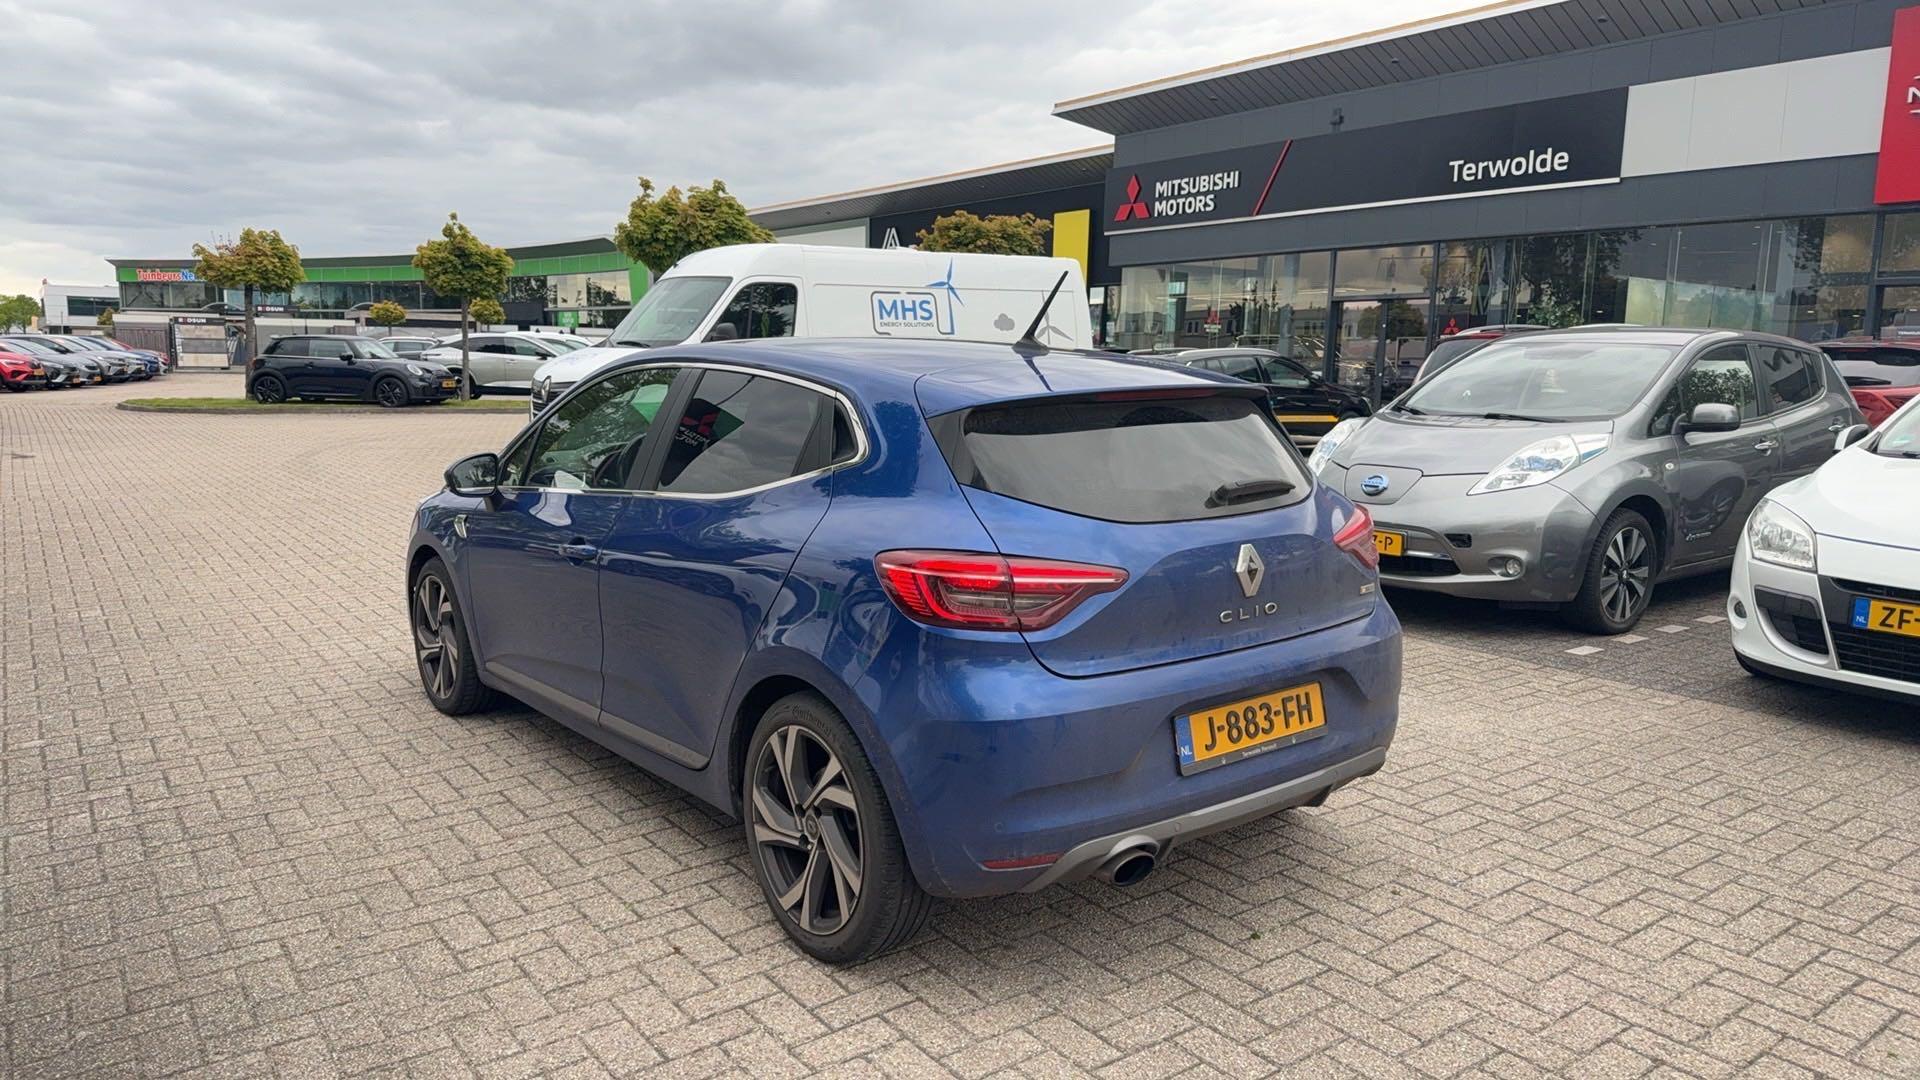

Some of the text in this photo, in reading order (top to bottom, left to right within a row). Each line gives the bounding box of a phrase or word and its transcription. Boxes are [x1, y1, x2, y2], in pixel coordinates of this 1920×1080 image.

[1449, 147, 1569, 182] Terwolde
[1155, 170, 1239, 198] MITSUBISHI
[1154, 194, 1215, 217] MOTORS
[136, 268, 196, 282] TuinbeursNe
[878, 299, 933, 321] MHS
[1219, 602, 1278, 623] CLIO
[1856, 615, 1867, 624] NL
[1205, 692, 1313, 751] J-883-FH
[1180, 745, 1193, 756] NL
